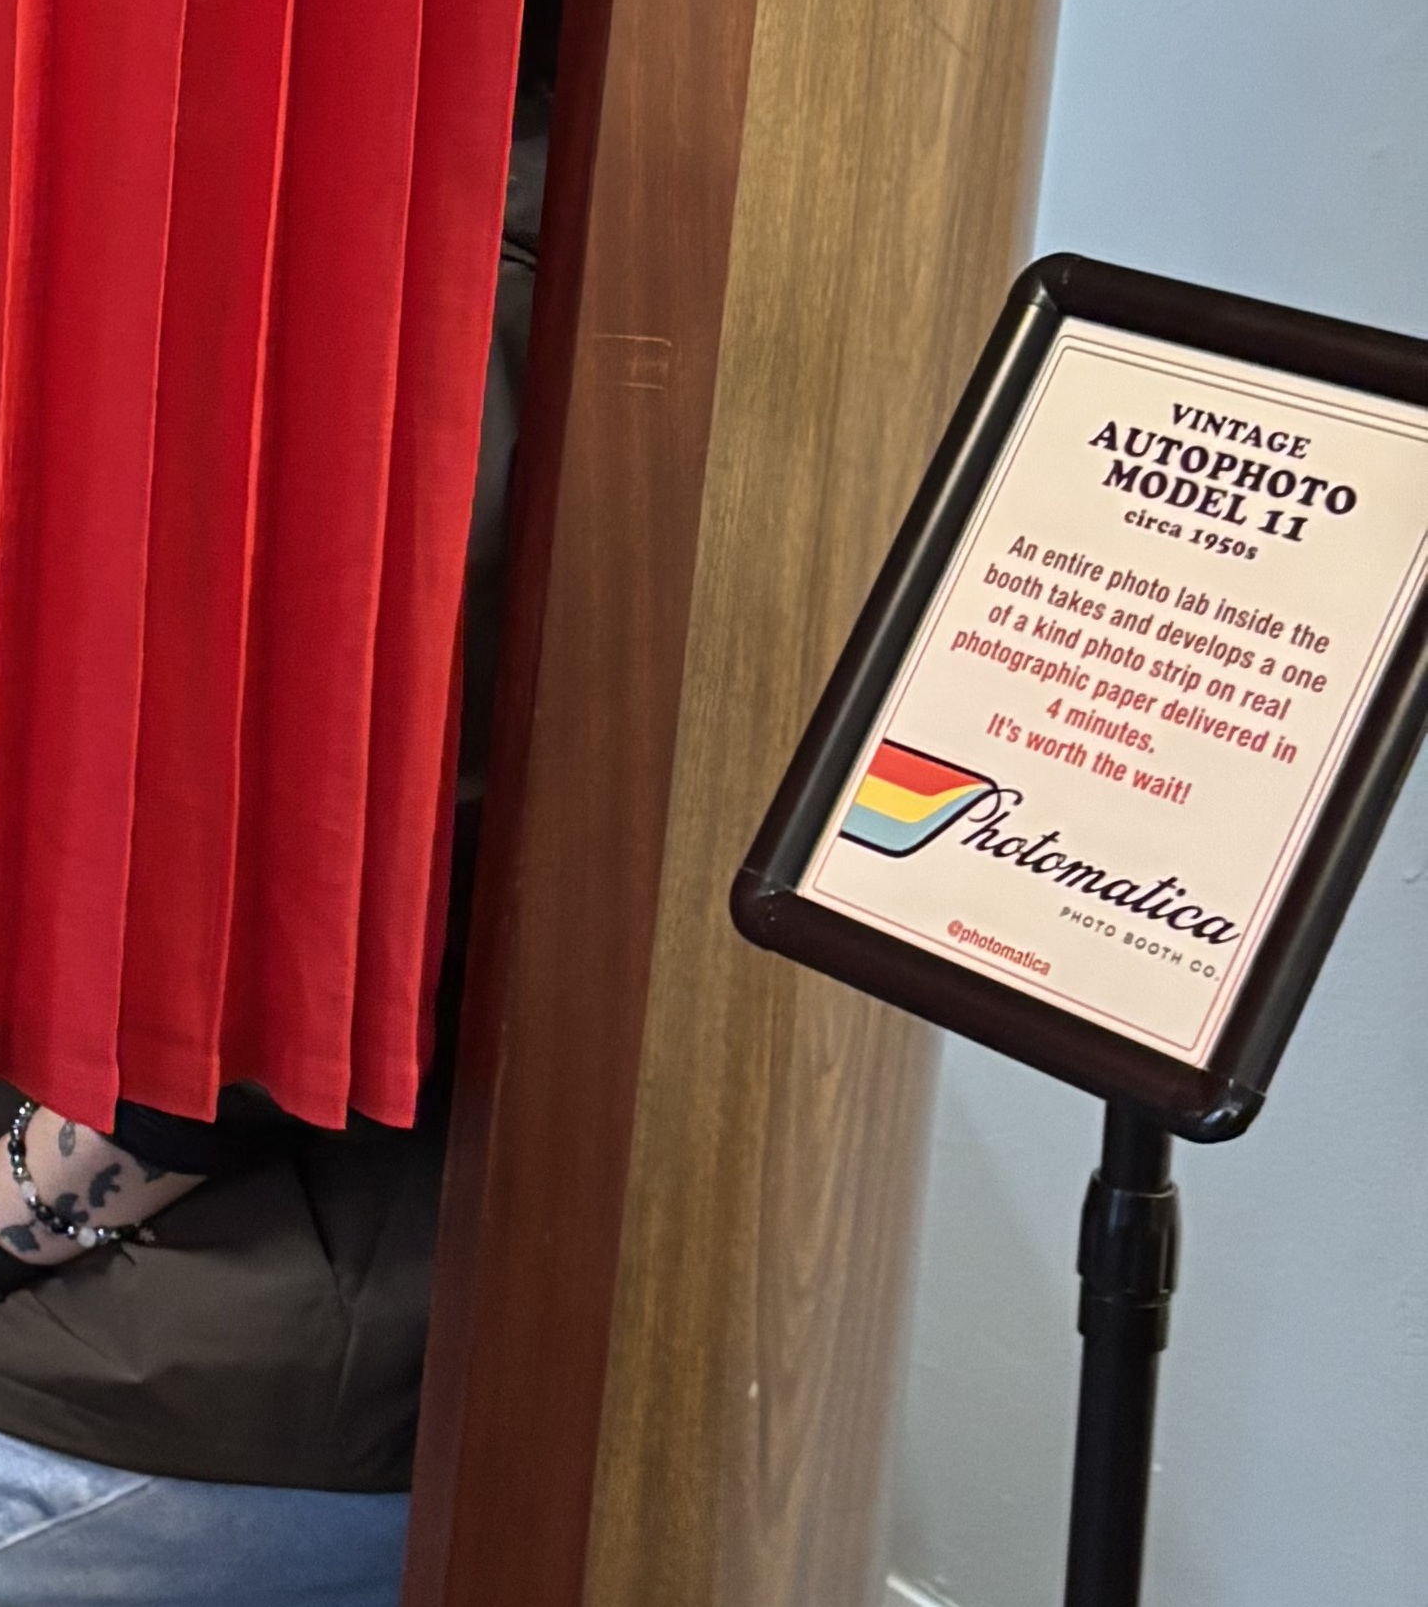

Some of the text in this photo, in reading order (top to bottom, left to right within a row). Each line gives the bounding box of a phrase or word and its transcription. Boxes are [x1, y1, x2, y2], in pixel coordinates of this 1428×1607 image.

[1088, 420, 1358, 515] AUTOPHOTO
[1172, 403, 1311, 460] VINTAGE
[1102, 459, 1308, 542] MODEL 11
[1124, 509, 1259, 560] circa 1950s
[983, 563, 1327, 693] booth takes and develops a one
[1008, 535, 1330, 654] An entire photo lab inside the
[950, 630, 1297, 764] photographic paper delivered in
[988, 605, 1292, 721] of a kind photo strip on real
[986, 713, 1192, 805] It's worth the wait!
[1046, 698, 1155, 754] 4 minutes.
[959, 786, 1240, 945] Photomatica
[947, 920, 1052, 977] @photomatica
[1059, 906, 1220, 981] PHOTO BOOTH CO.
